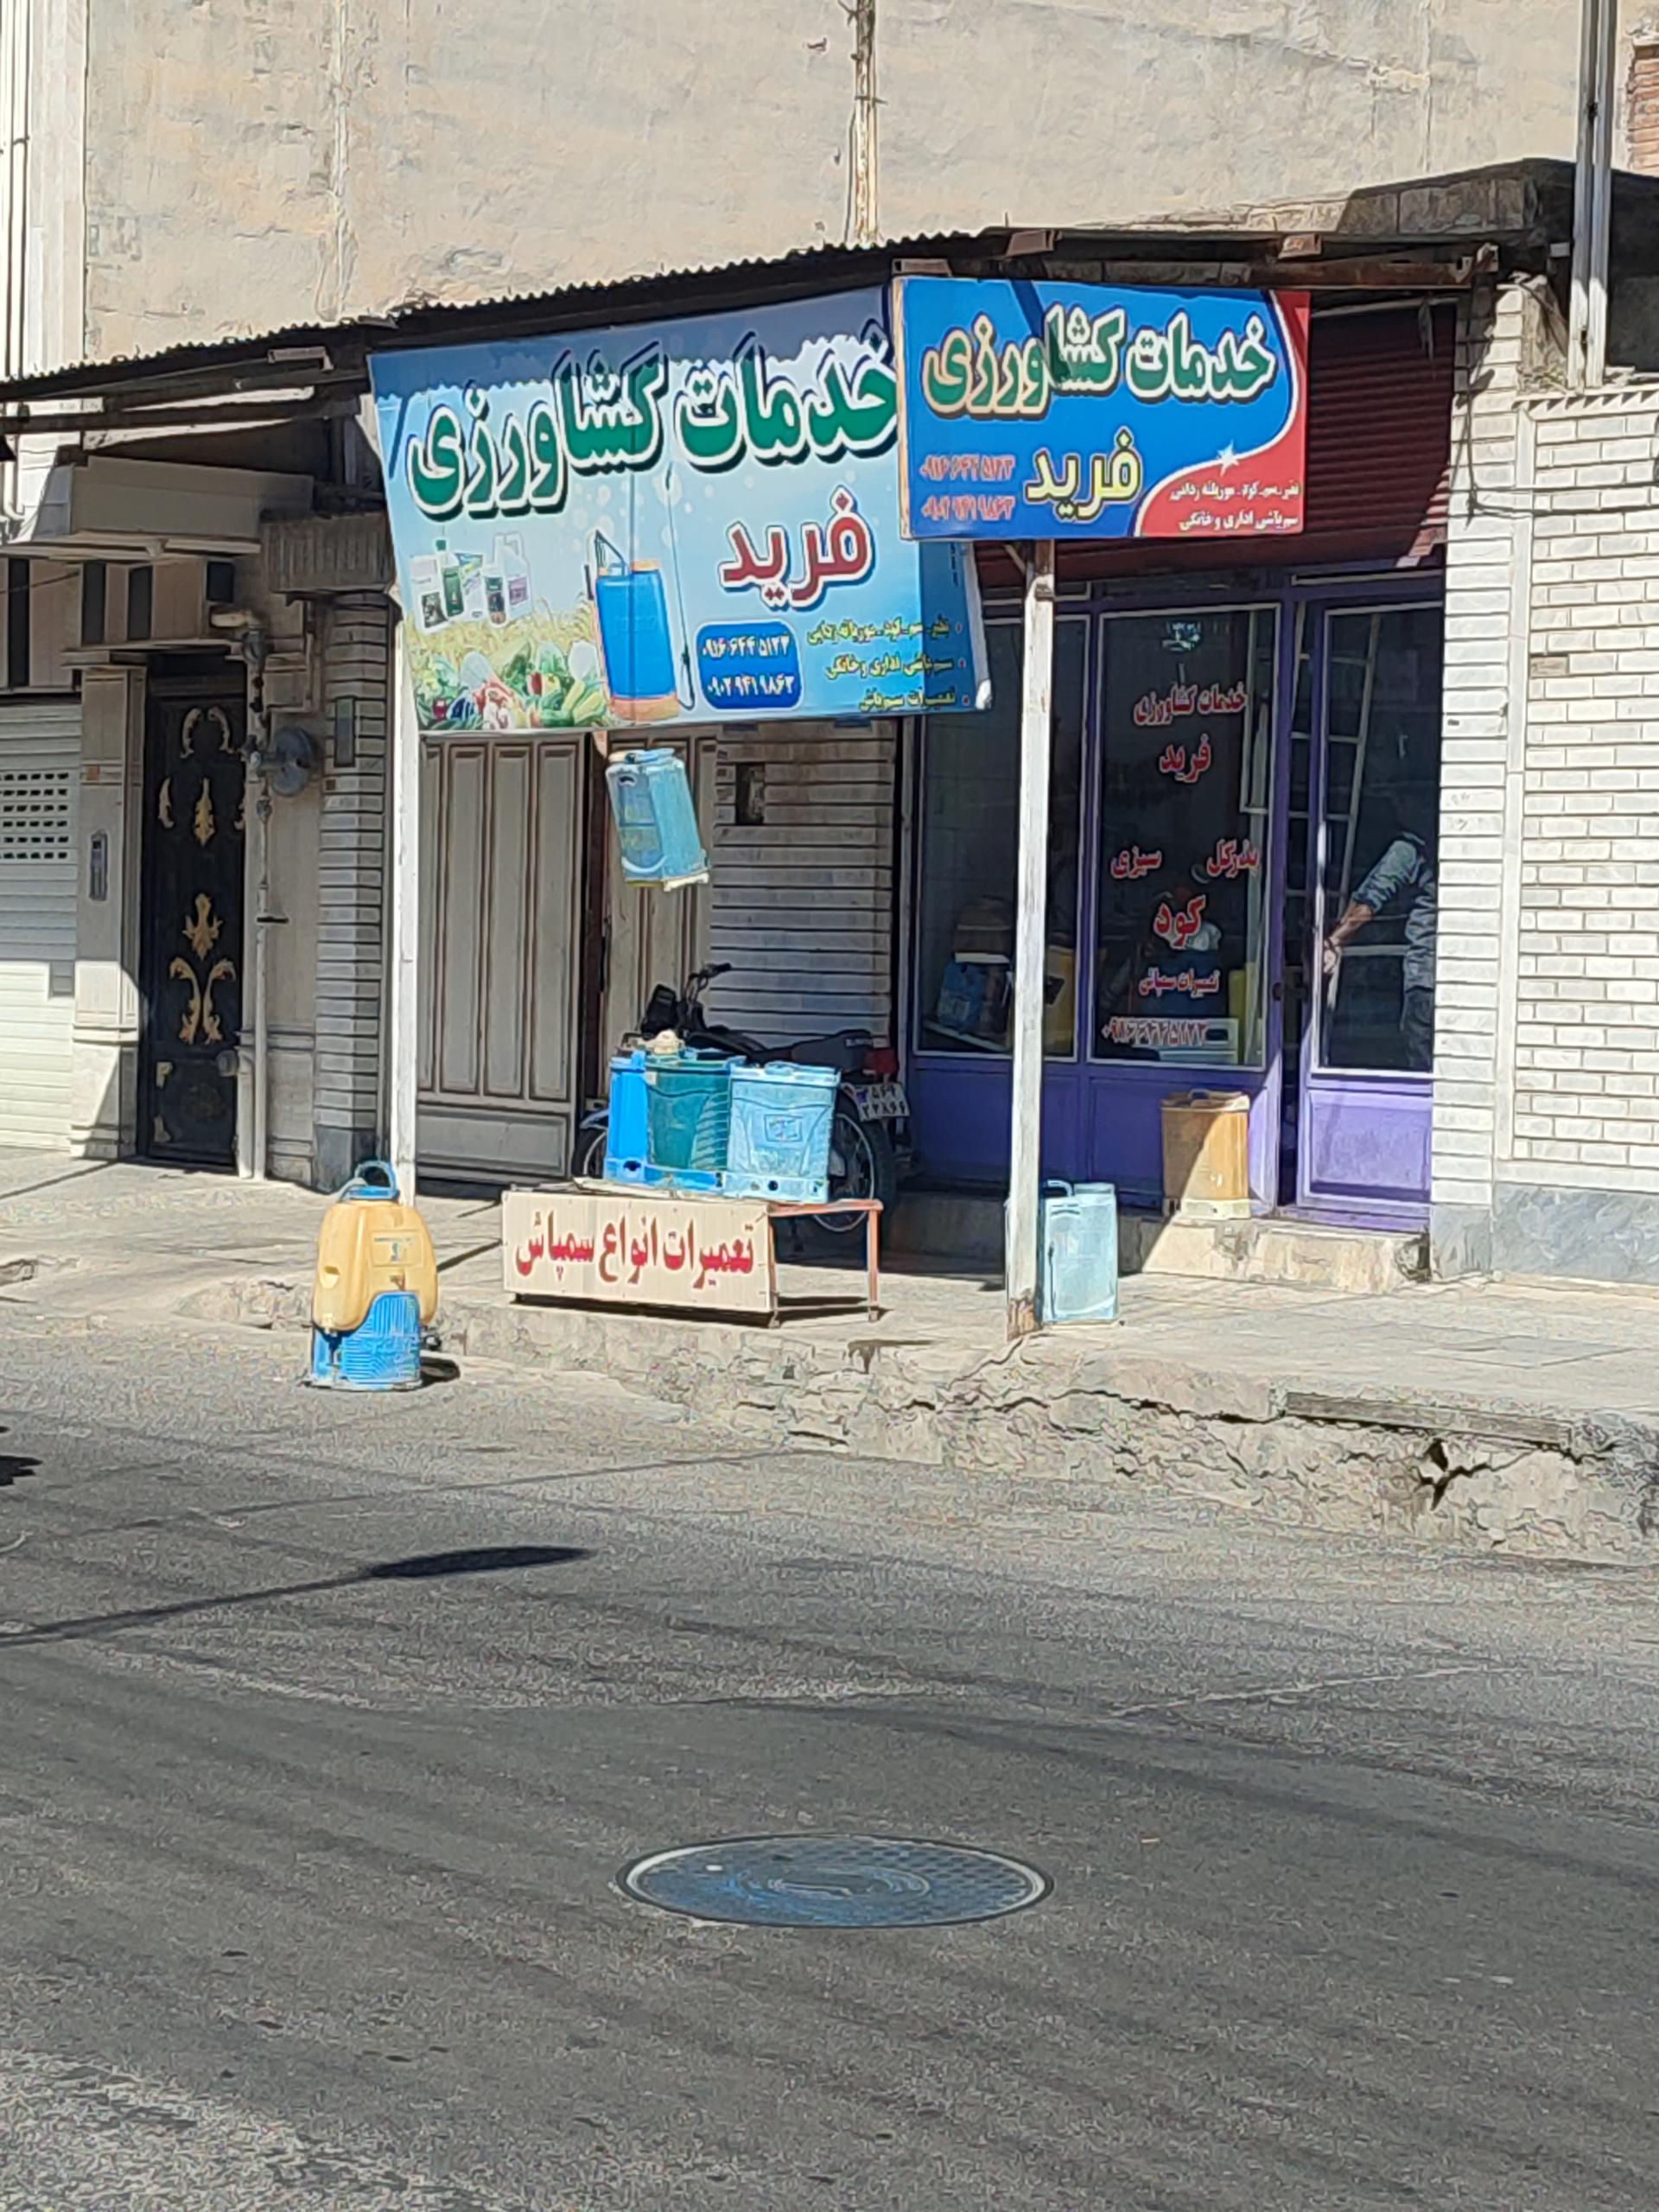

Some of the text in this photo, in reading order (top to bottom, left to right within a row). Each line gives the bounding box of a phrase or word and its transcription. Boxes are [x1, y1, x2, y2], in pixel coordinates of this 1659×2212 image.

[924, 302, 1278, 419] خدمات کشاورزی
[406, 323, 899, 518] خدمات کشاورزی
[1025, 429, 1142, 522] فرید
[719, 486, 874, 613] فرید
[1134, 681, 1247, 725] خدمات کشاورزی
[1160, 734, 1211, 783] فرید
[1154, 894, 1206, 950] کود
[514, 1211, 757, 1290] تعمیرات انواع سمپاش
